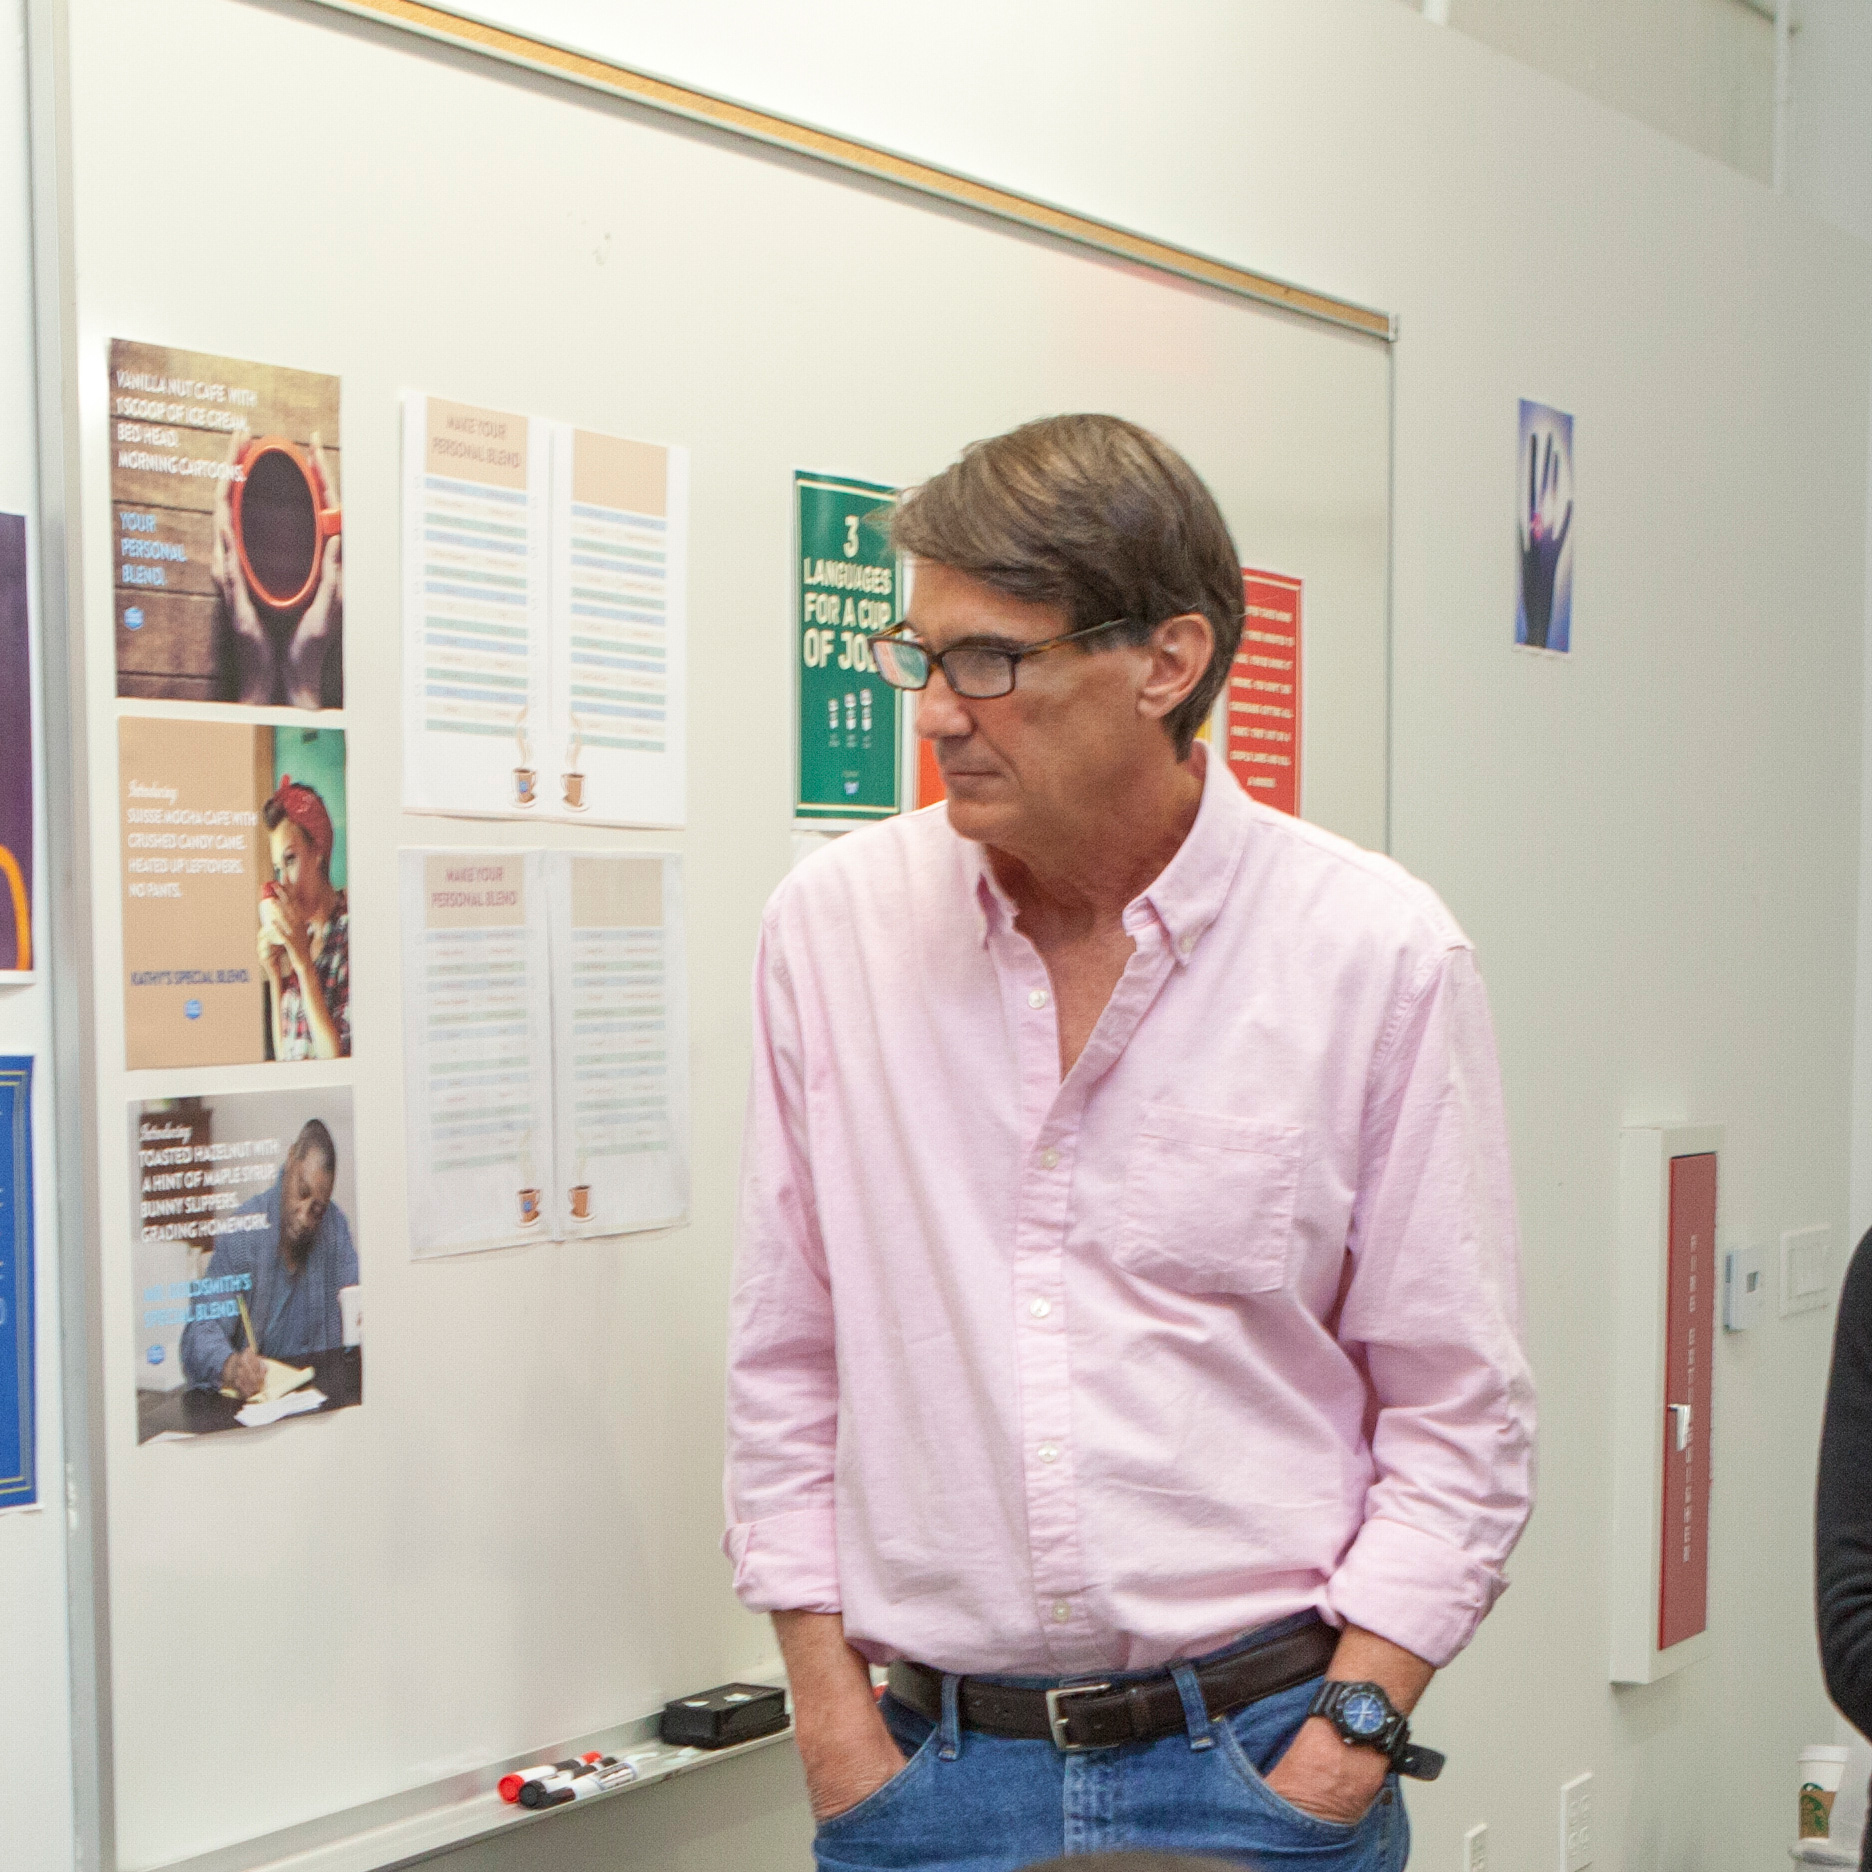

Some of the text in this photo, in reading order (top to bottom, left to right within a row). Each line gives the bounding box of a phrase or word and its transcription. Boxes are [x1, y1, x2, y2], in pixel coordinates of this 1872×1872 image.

[116, 370, 167, 394] VANILLA
[168, 379, 195, 398] NUT
[194, 381, 227, 402] CAFE
[124, 397, 167, 420] SCOOP
[167, 403, 186, 423] OF
[186, 406, 208, 427] ICE
[117, 422, 142, 442] BED
[118, 450, 178, 474] MORNING
[120, 511, 157, 533] YOUR
[842, 514, 860, 558] 3
[121, 537, 187, 562] PERSONAL
[803, 556, 893, 595] LANGUAGES
[804, 591, 893, 631] FOR A CUP
[803, 627, 878, 674] OF JO
[128, 833, 177, 849] CRUSHED
[128, 882, 145, 898] NO
[138, 1144, 193, 1168] TOASTED
[142, 1175, 152, 1194] A
[152, 1171, 184, 1192] HINT
[183, 1168, 205, 1189] OF
[141, 1197, 184, 1219] BUNNY
[141, 1220, 199, 1242] GRADING
[1683, 1327, 1696, 1563] EXTIGUISHER
